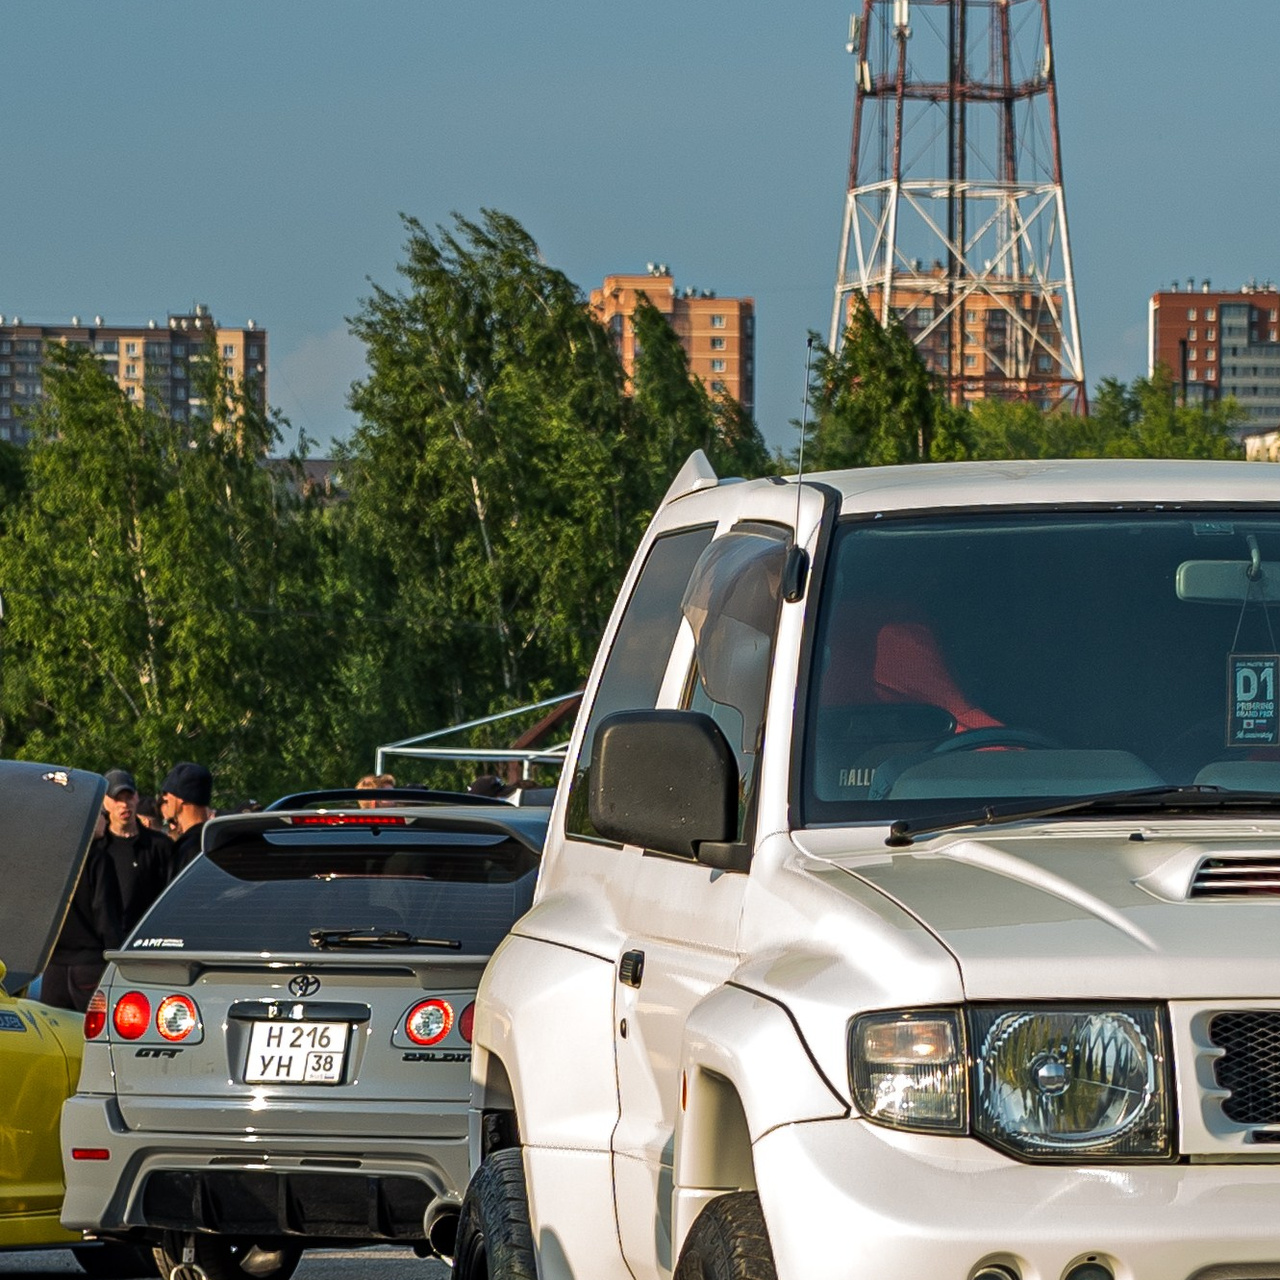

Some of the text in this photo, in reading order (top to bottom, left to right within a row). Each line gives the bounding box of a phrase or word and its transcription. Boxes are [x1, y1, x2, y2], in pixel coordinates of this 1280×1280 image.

[1236, 667, 1274, 701] D1
[266, 1026, 331, 1049] Н 216
[260, 1055, 293, 1077] УН
[311, 1054, 334, 1072] 38
